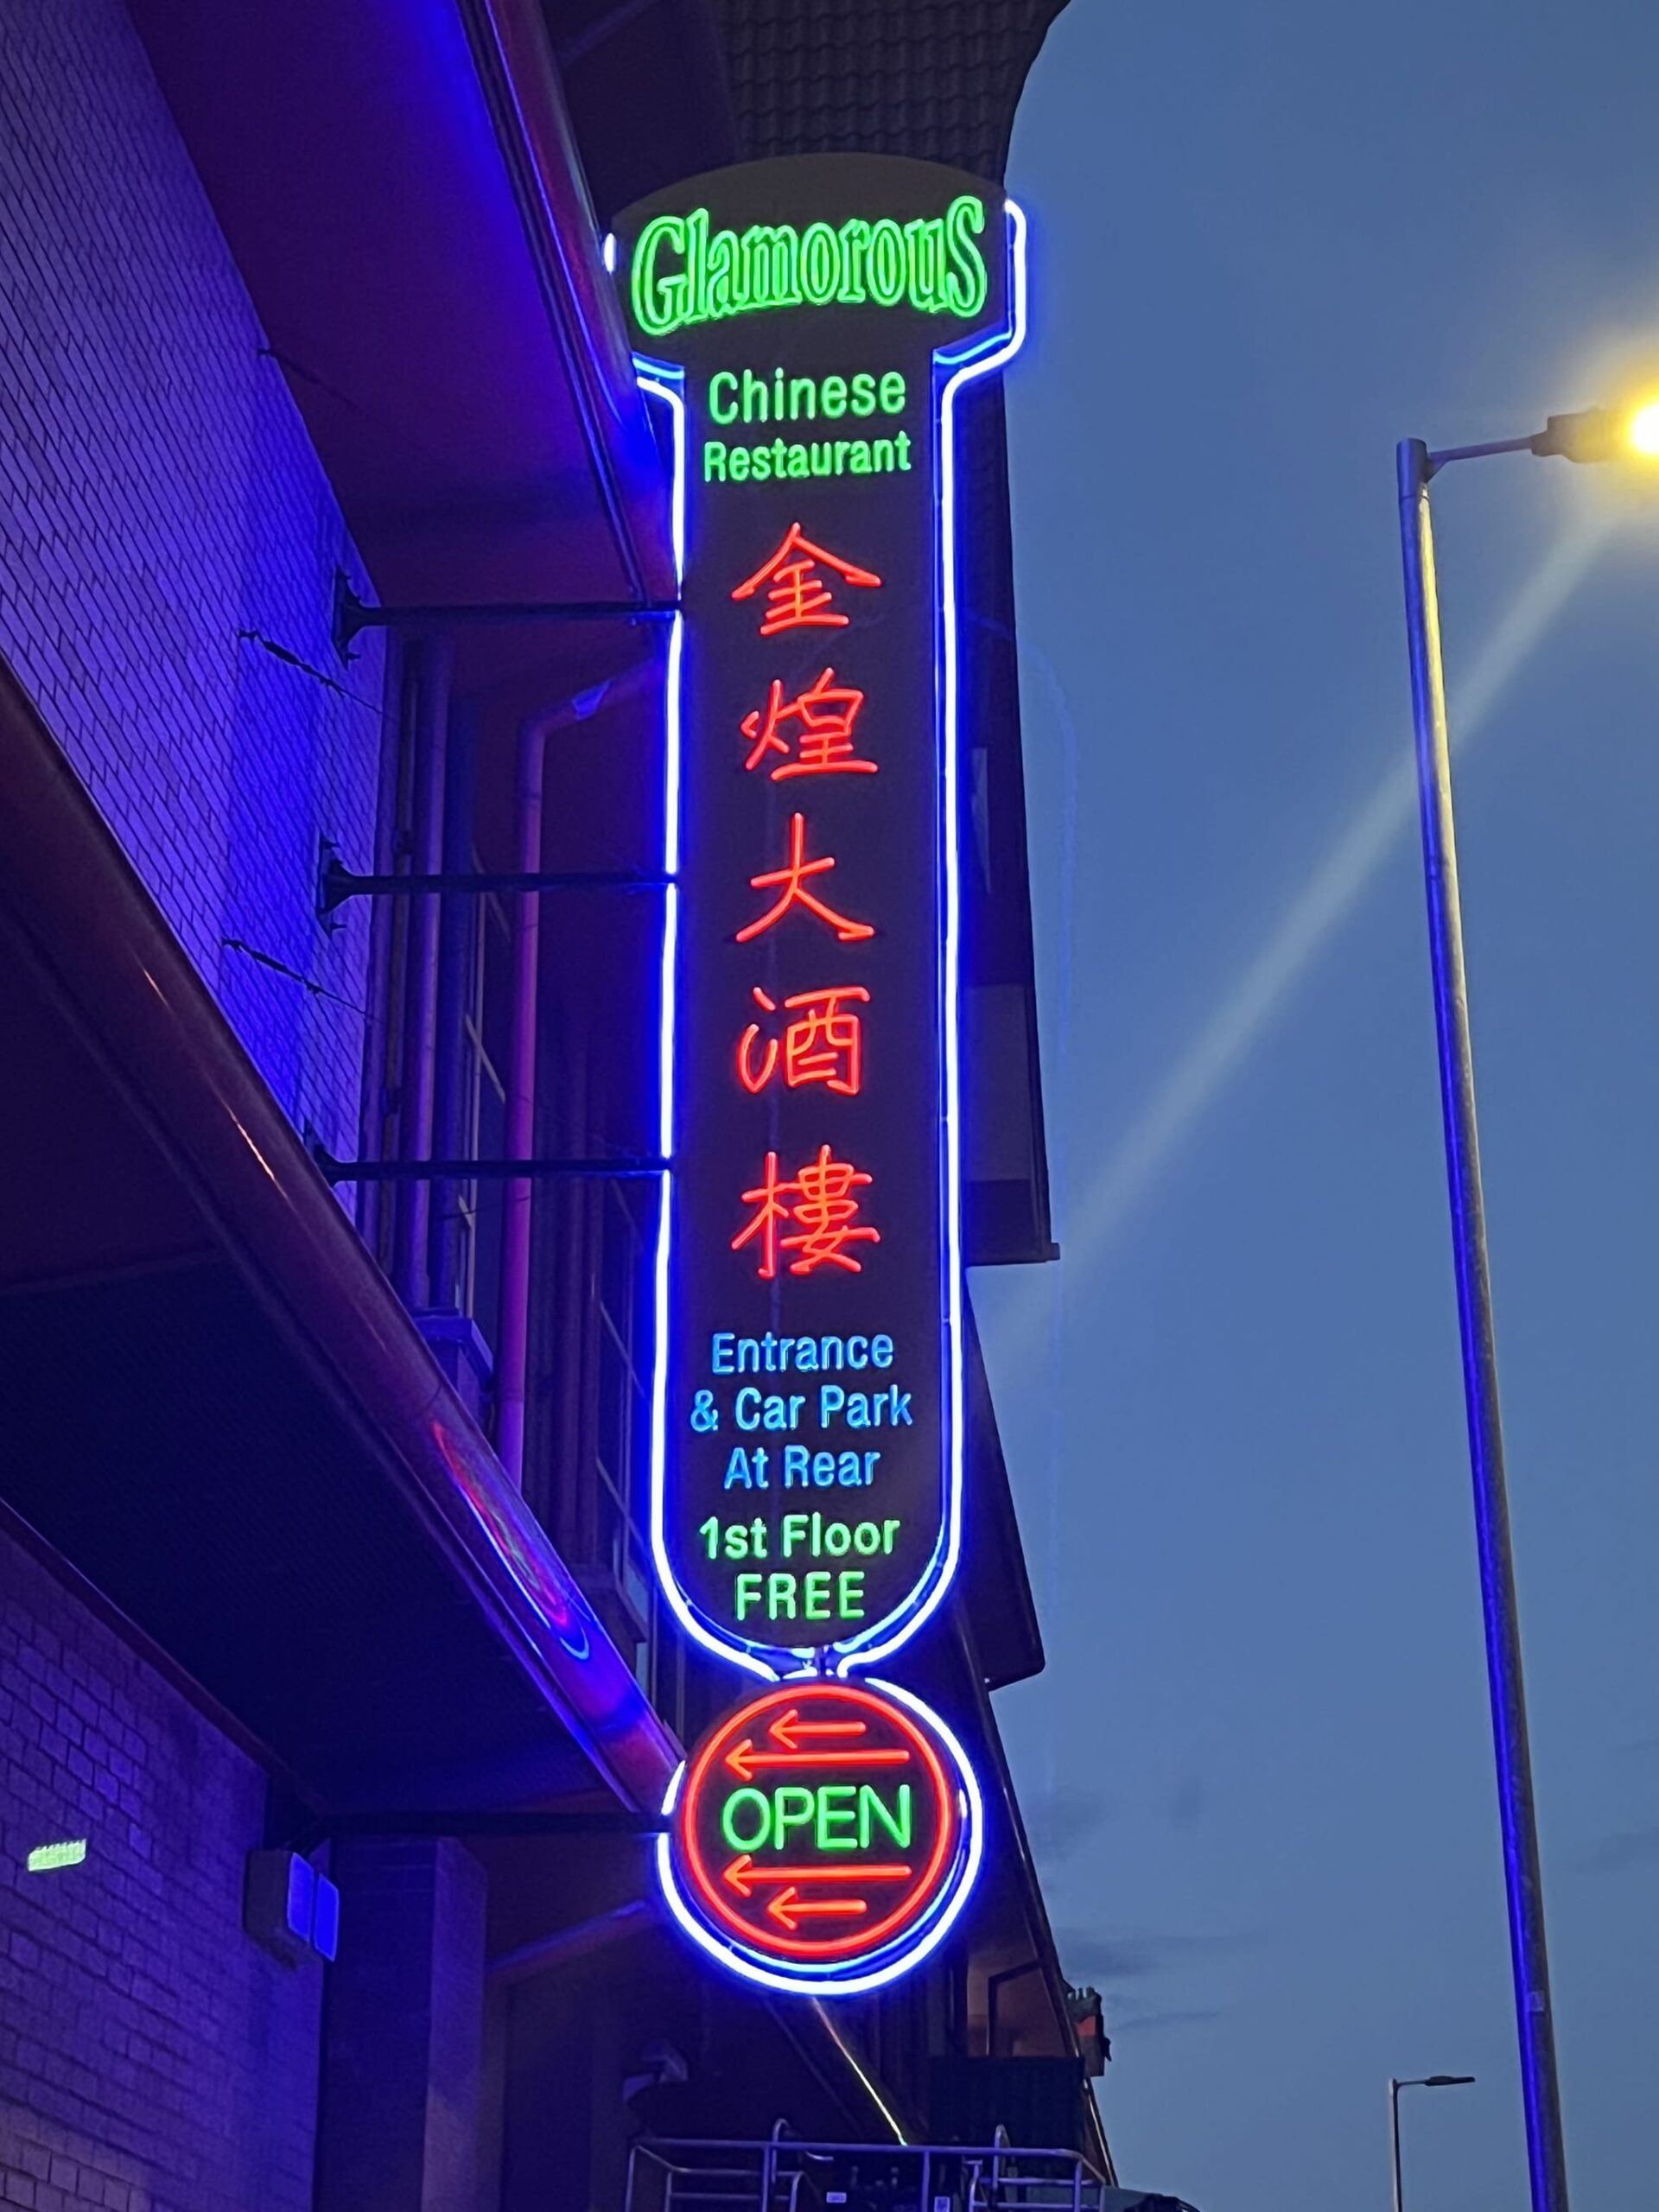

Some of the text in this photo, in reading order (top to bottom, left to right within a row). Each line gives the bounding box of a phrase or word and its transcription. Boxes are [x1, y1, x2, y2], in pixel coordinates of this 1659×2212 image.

[709, 367, 907, 426] Chinese
[704, 430, 912, 483] Restaurant
[731, 522, 882, 1280] 金煌大酒樓
[711, 1332, 894, 1374] Entrance
[690, 1384, 913, 1432] & Car Park
[723, 1445, 880, 1490] At Rear
[699, 1511, 900, 1560] 1st Floor
[735, 1571, 865, 1621] FREE
[721, 1784, 911, 1853] OPEN
